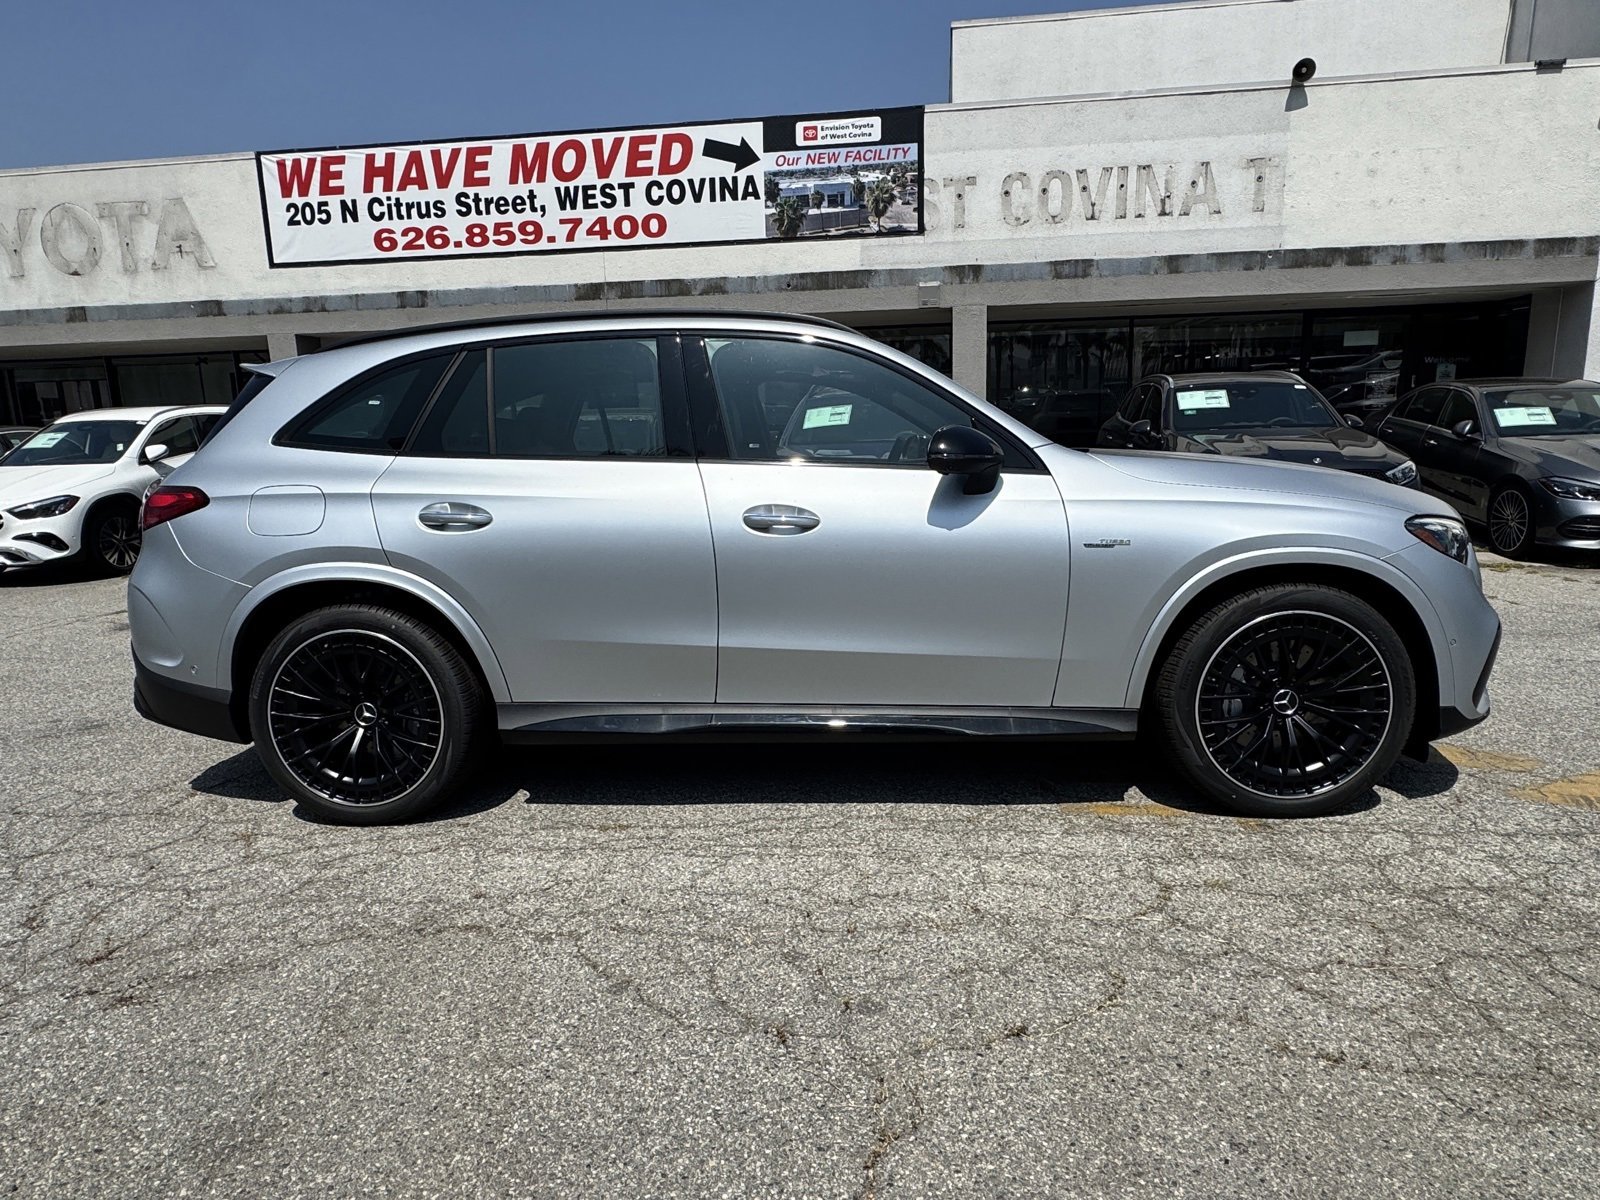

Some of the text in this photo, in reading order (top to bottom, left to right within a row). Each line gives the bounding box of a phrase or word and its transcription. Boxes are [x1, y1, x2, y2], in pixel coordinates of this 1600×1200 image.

[820, 122, 875, 132] Envision Toyota
[829, 132, 848, 140] West
[848, 131, 872, 139] Covina
[276, 132, 694, 199] WE HAVE MOVED
[775, 146, 912, 167] Our NEW FACILITY
[286, 174, 762, 227] 205 N Citrus Street, WEST COVINA
[1000, 161, 1222, 228] COVINA
[373, 212, 668, 253] 626.859.7400
